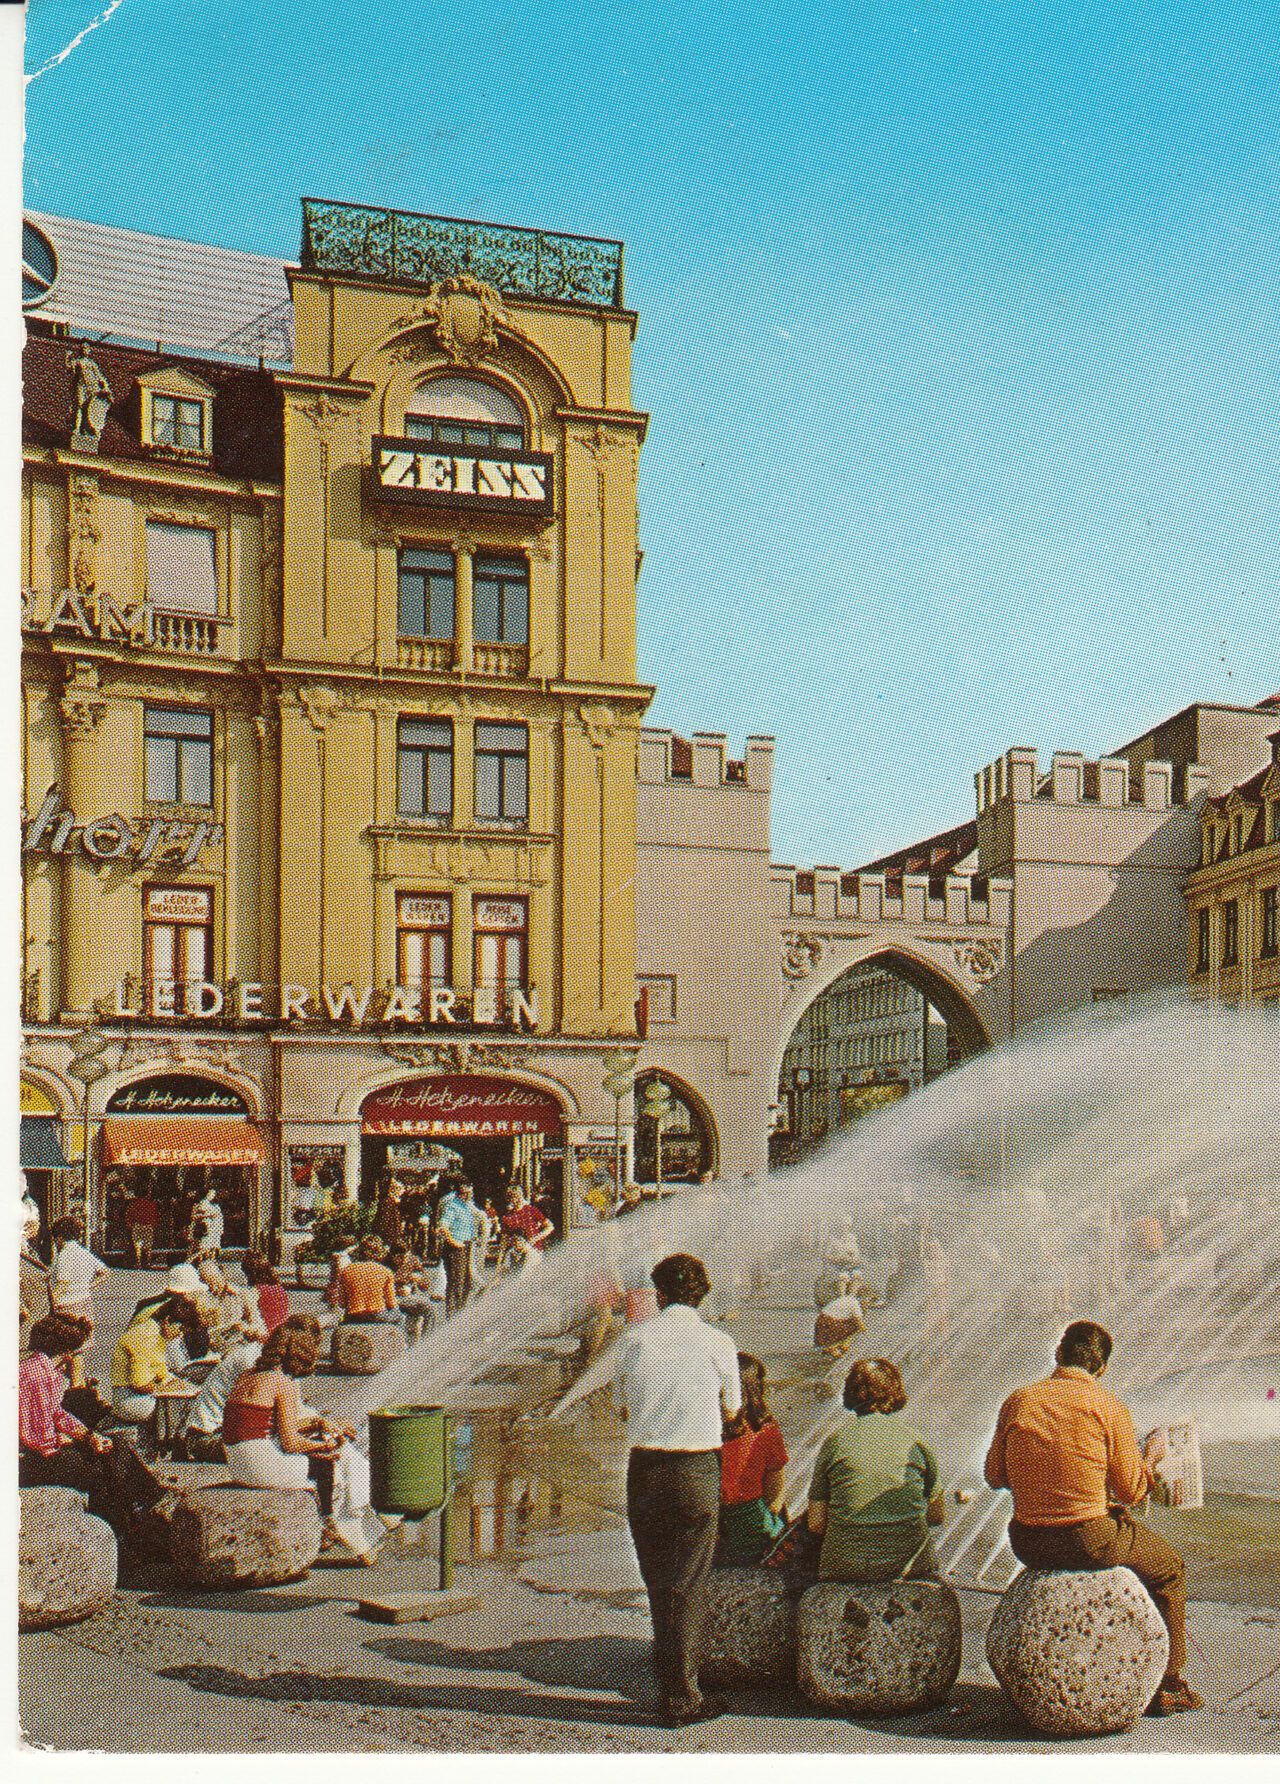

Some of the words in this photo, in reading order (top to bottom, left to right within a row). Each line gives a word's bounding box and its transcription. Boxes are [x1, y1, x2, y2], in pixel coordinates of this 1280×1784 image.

[380, 450, 545, 500] ZEISS
[115, 981, 541, 1030] LEDERWAREN
[388, 1119, 540, 1133] LEDERWAREN
